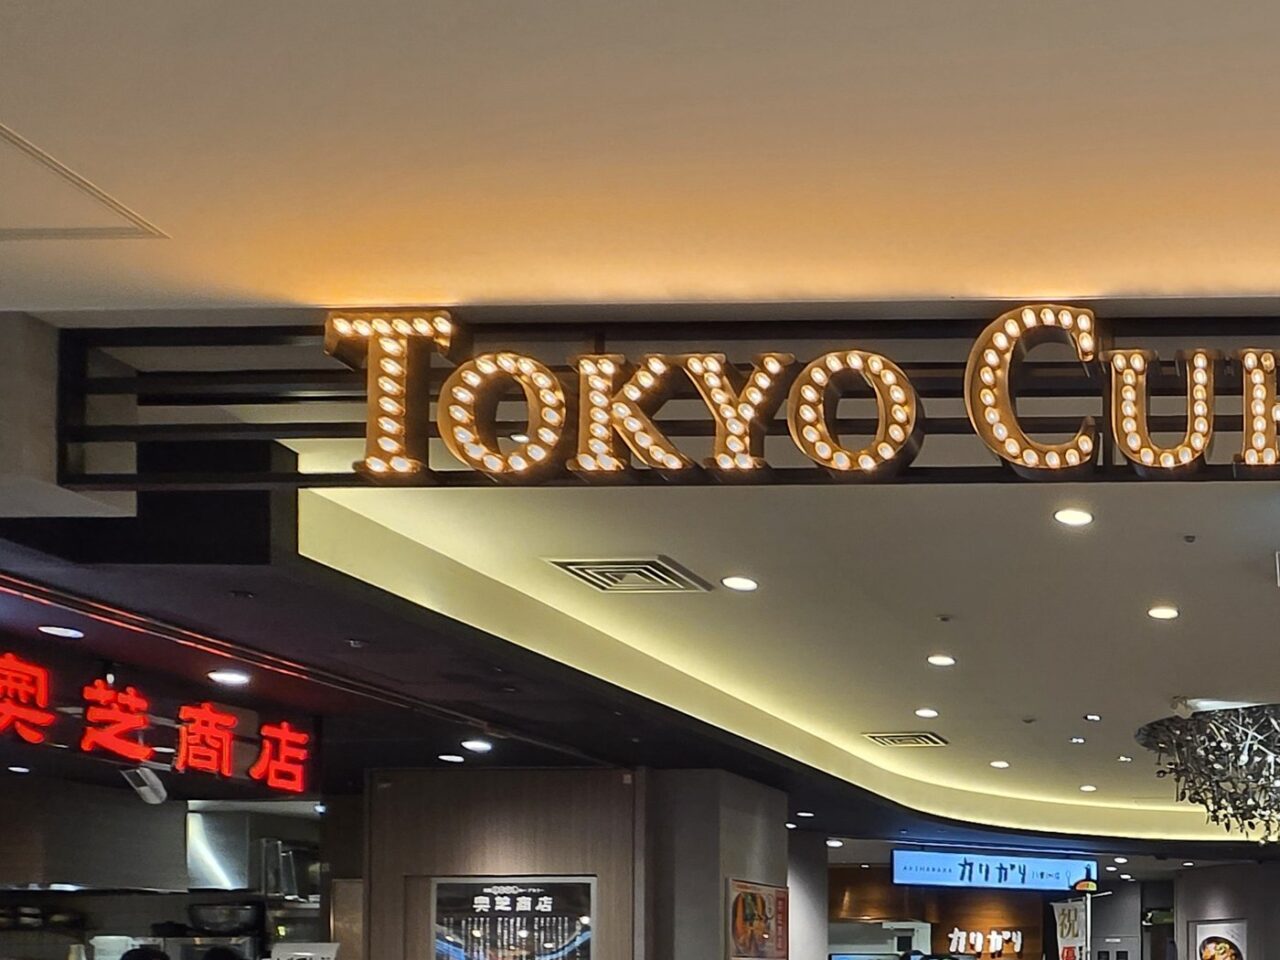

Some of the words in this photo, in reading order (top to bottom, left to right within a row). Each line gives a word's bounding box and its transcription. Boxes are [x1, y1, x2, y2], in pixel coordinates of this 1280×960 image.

[325, 311, 920, 475] TOKYO
[0, 652, 312, 793] 奥芝商店
[472, 895, 553, 913] 奥芝商店
[1059, 908, 1079, 939] 祝
